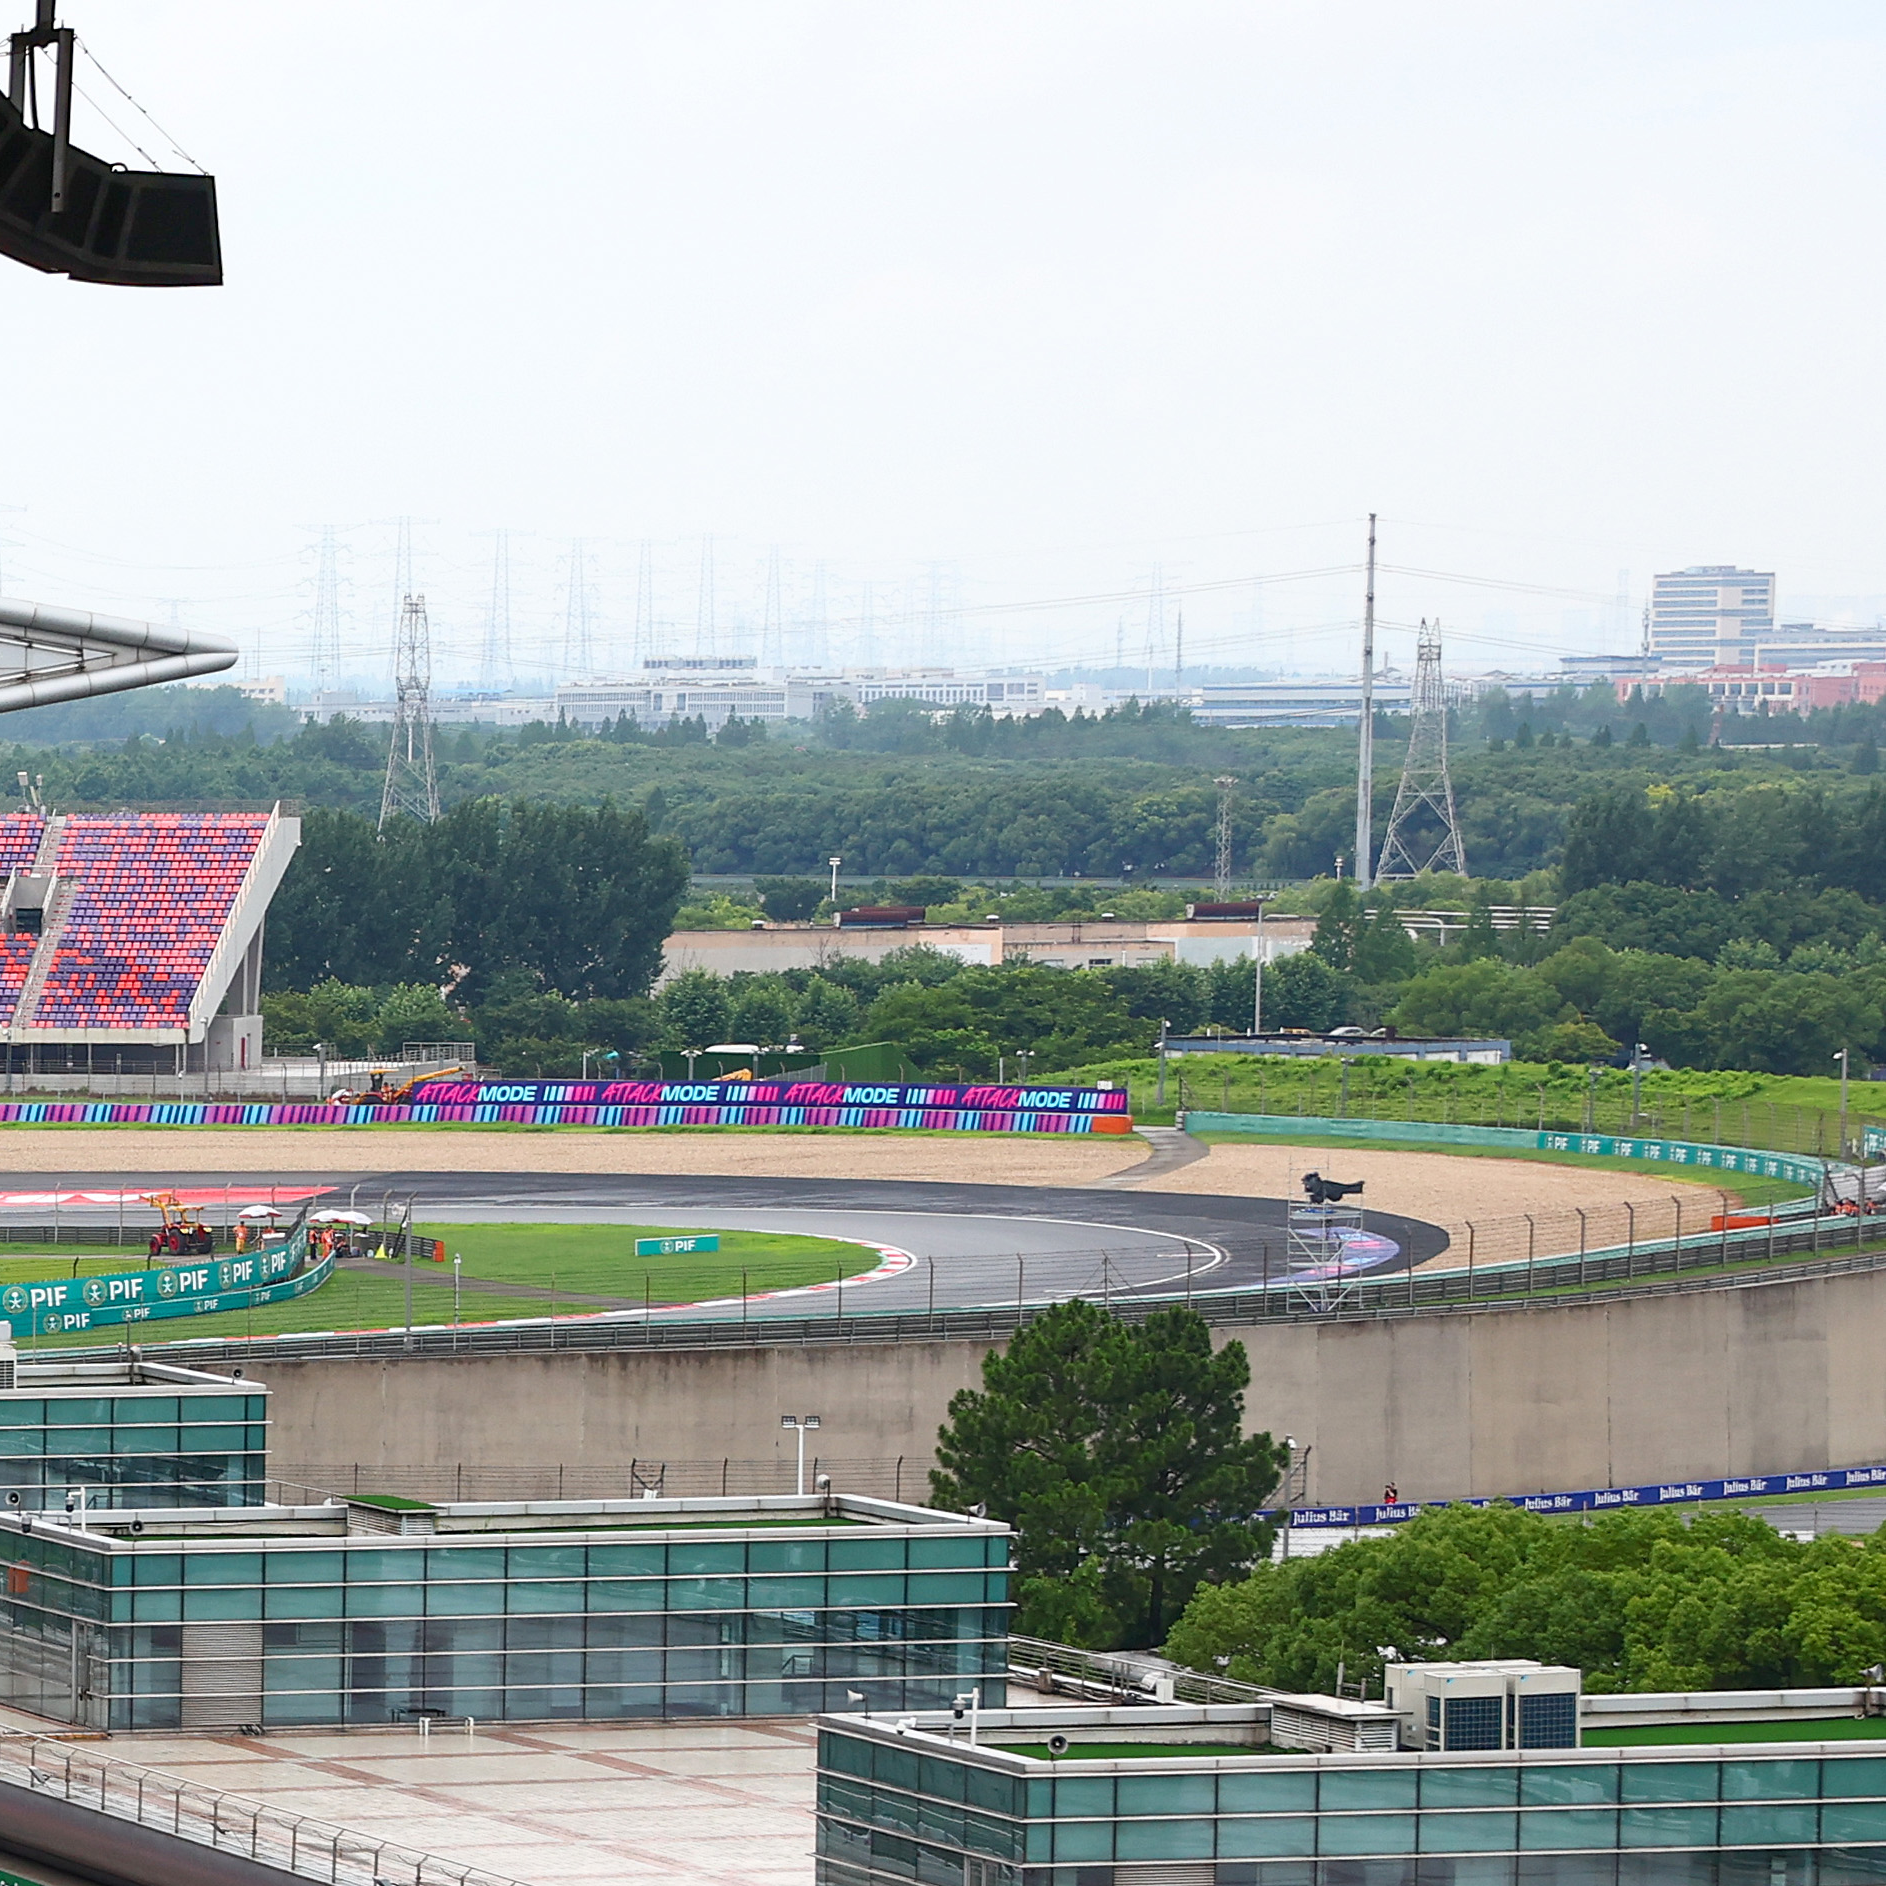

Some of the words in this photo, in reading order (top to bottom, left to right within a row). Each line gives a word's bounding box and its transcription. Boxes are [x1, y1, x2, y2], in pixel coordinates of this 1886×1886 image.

[271, 1251, 287, 1273] PIF
[233, 1261, 253, 1282] PIF
[110, 1278, 144, 1300] PIF
[180, 1270, 209, 1292] PIF
[30, 1286, 68, 1308] PIF
[64, 1313, 90, 1329] PIF
[1787, 1476, 1809, 1490] Julius
[1595, 1493, 1620, 1506] Julius
[1659, 1487, 1684, 1500] Julius
[1525, 1498, 1551, 1512] Julius
[1293, 1510, 1325, 1526] Julius
